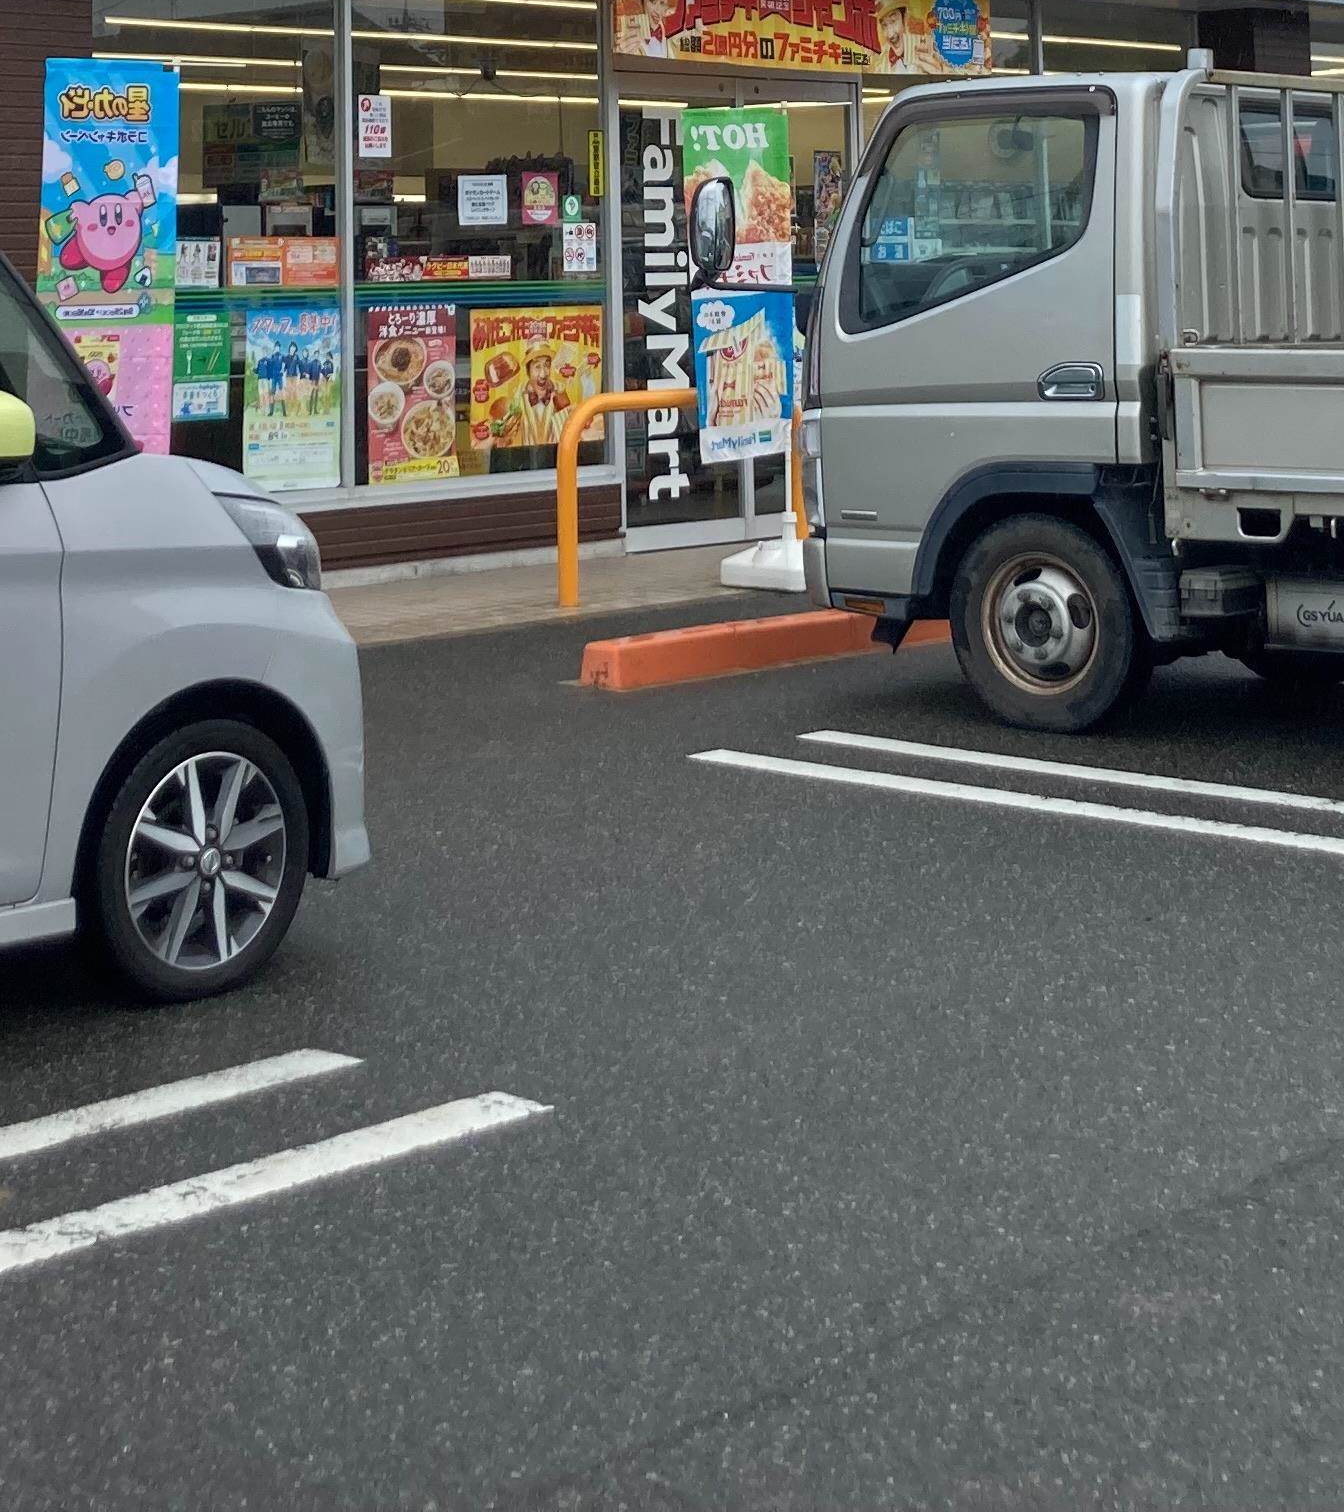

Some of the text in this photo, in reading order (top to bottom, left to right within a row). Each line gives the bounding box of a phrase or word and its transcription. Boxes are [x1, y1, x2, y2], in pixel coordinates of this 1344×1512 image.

[638, 105, 690, 501] FamilyMart
[388, 310, 437, 325] とろーり濃厚
[1302, 609, 1318, 622] GS
